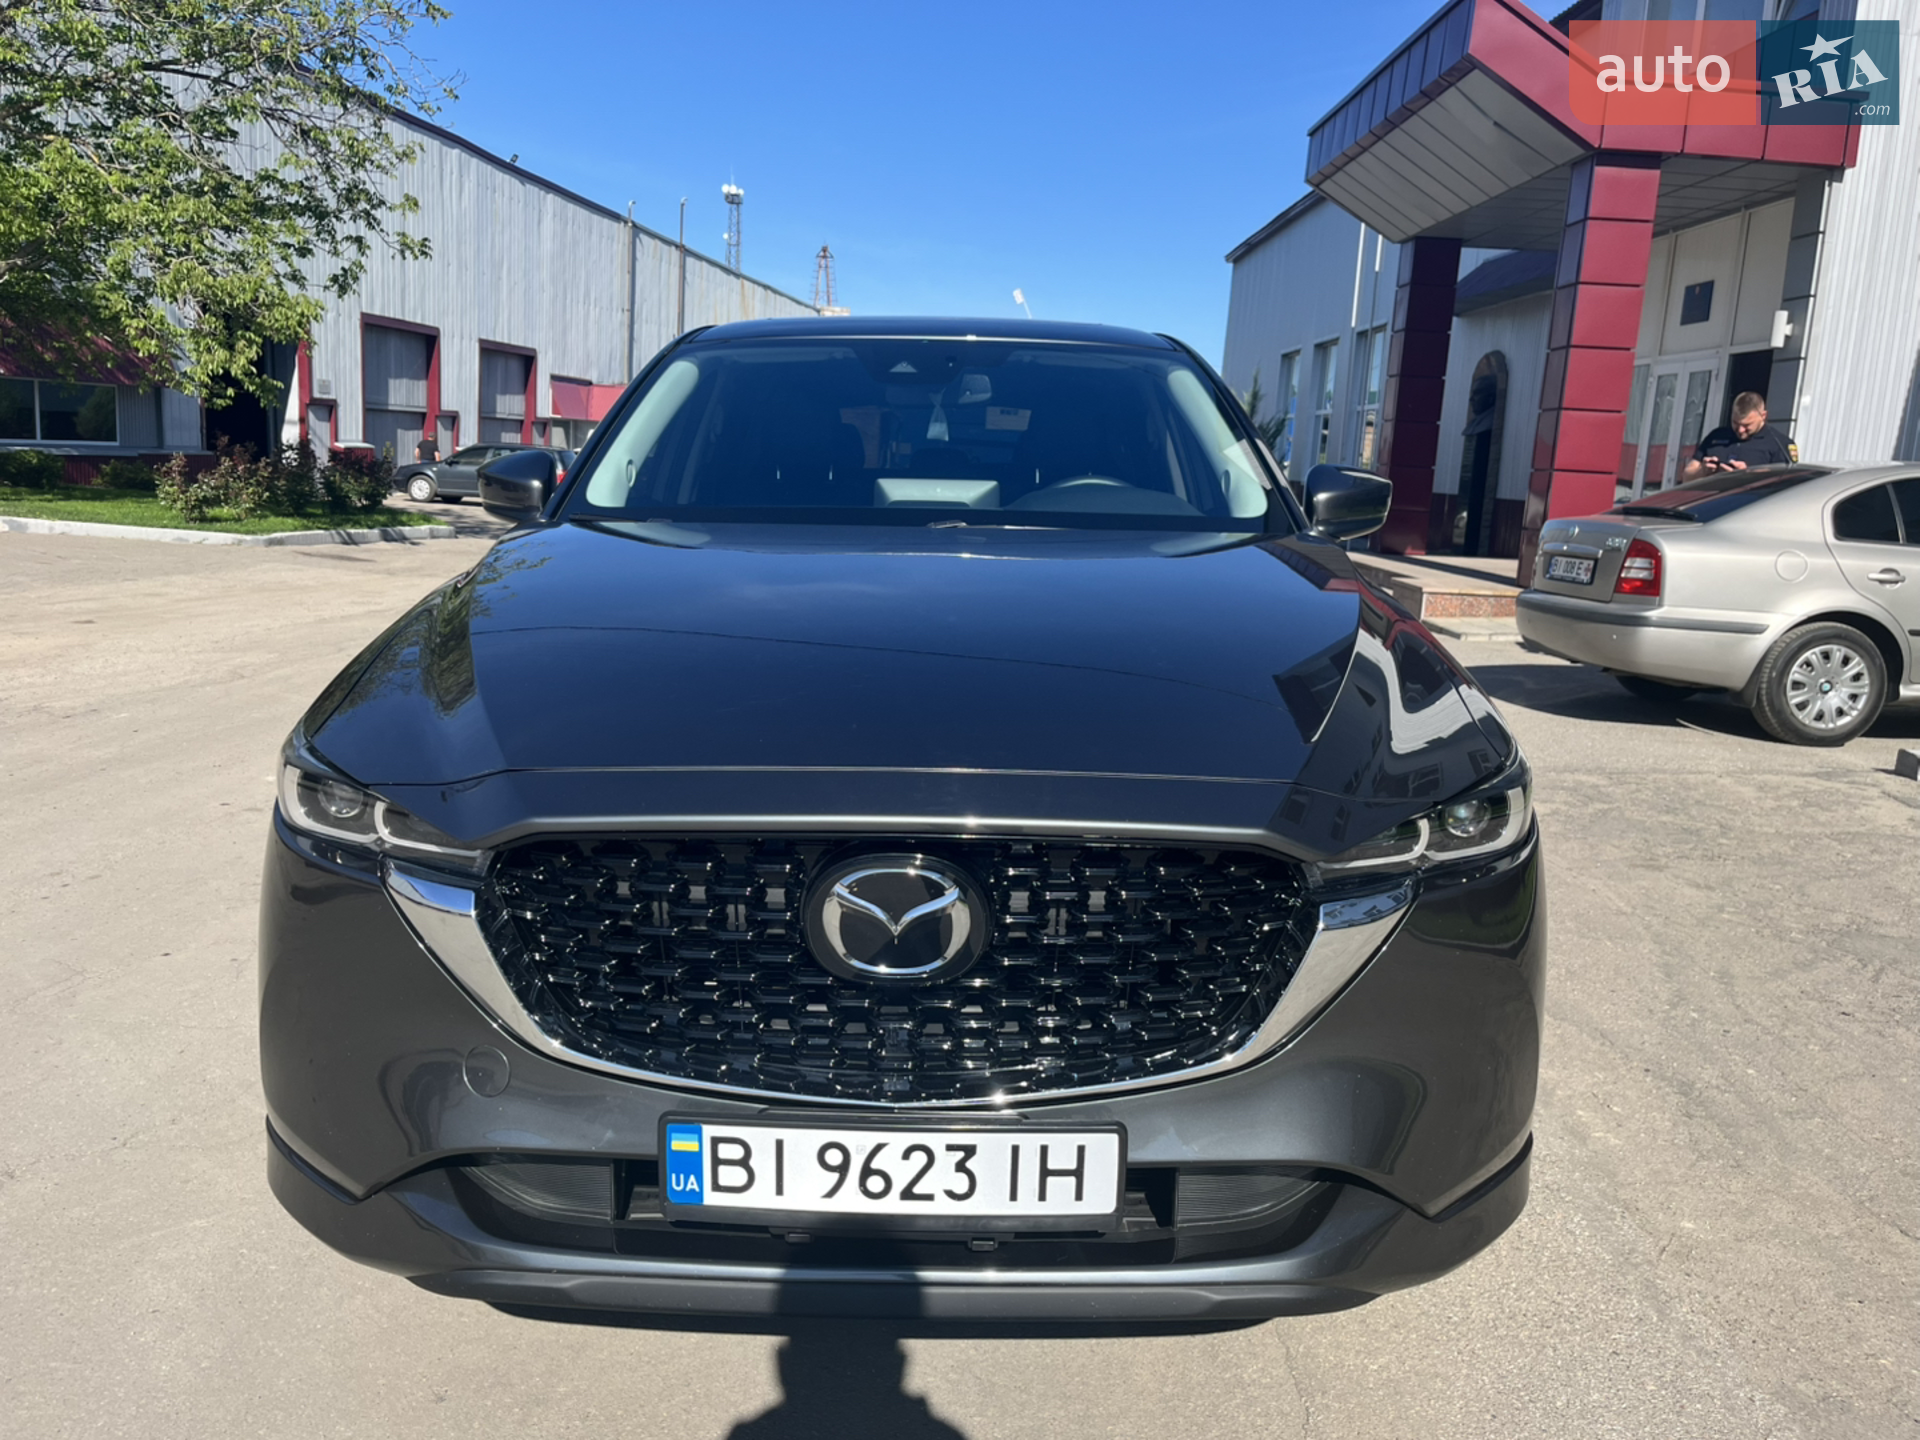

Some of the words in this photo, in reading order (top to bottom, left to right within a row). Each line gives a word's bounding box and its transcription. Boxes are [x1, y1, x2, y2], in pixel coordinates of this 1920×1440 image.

[671, 1173, 700, 1193] UA
[709, 1135, 785, 1196] BI
[816, 1140, 978, 1202] 9623
[1008, 1143, 1087, 1202] IH
